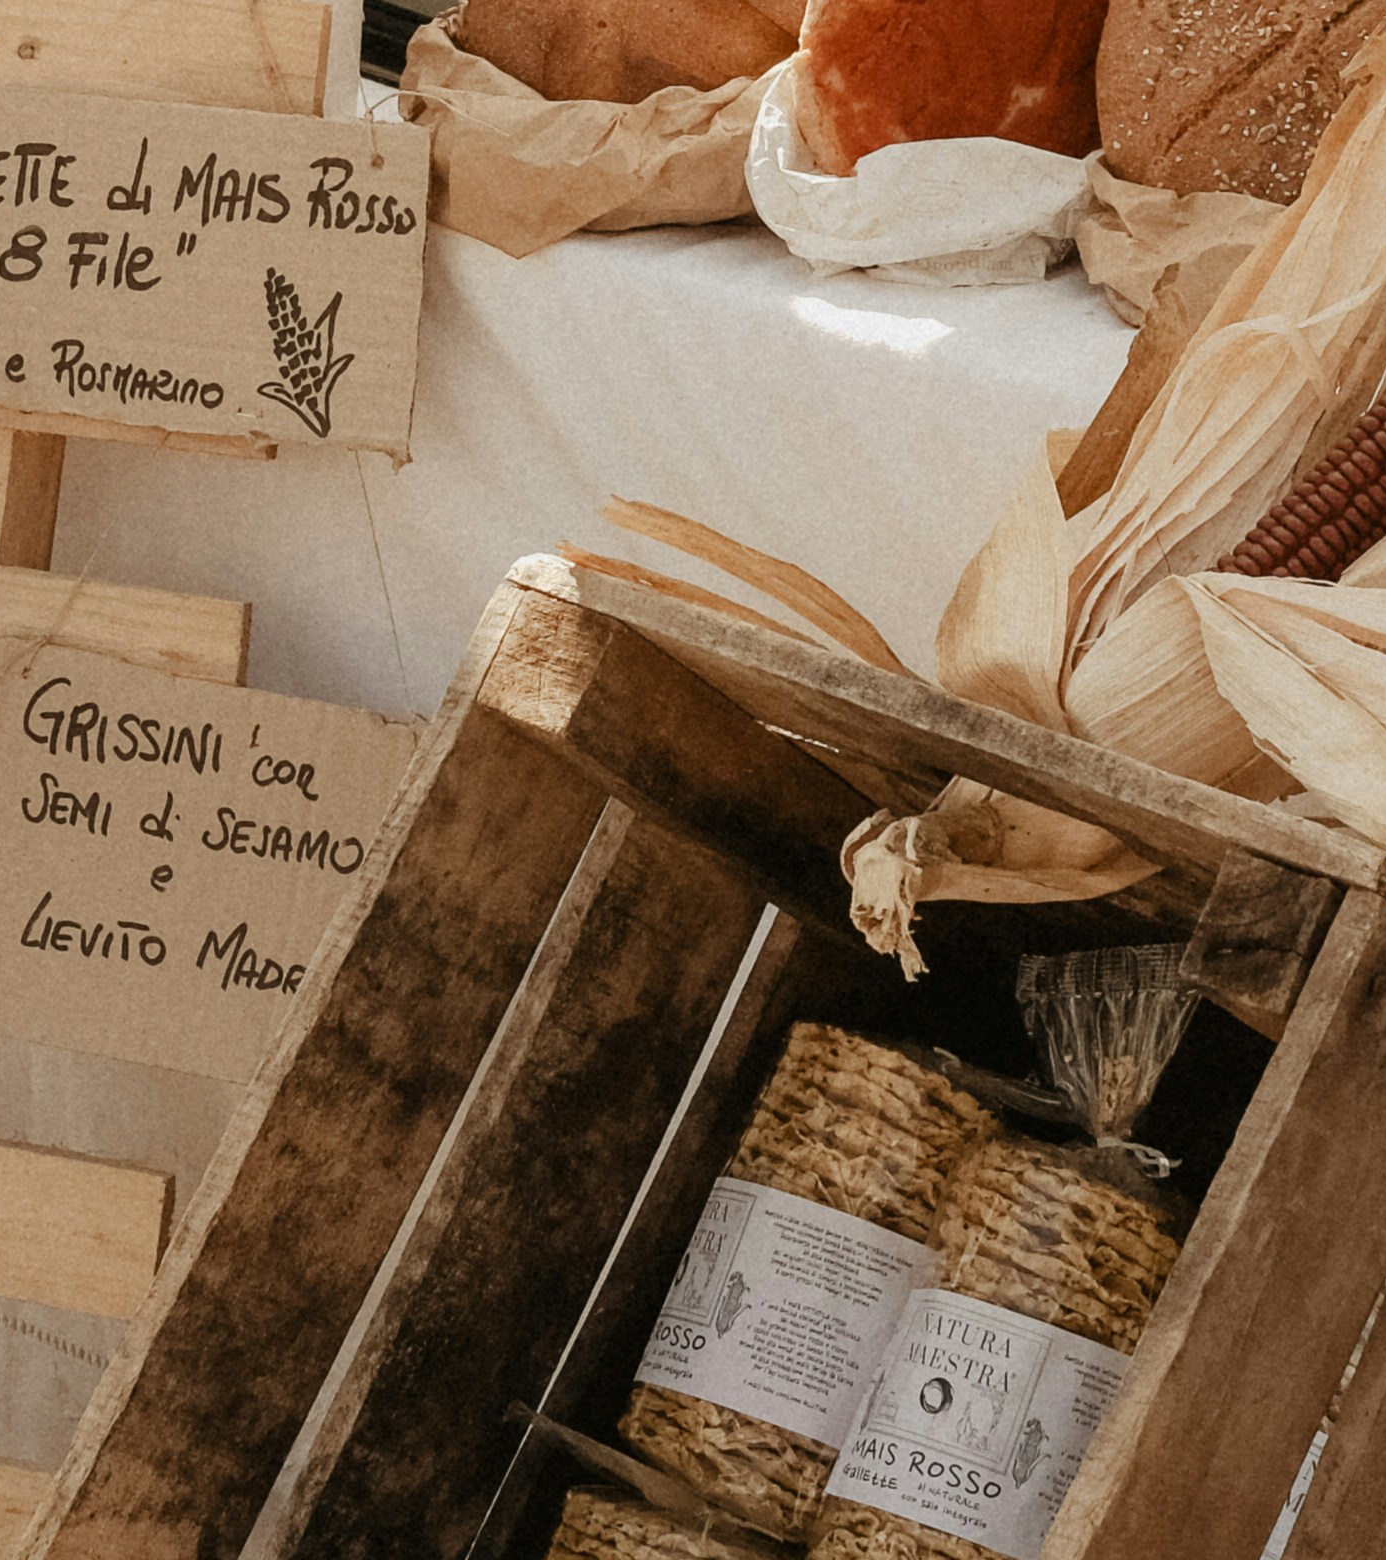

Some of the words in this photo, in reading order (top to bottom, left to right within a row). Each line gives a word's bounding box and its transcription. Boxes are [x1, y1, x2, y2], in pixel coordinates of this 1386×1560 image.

[106, 136, 152, 215] di
[173, 152, 290, 227] MAIS
[5, 351, 26, 382] e
[23, 678, 223, 774] GRISSINI
[21, 773, 112, 837] SEMI
[140, 791, 181, 841] di
[202, 806, 365, 875] SESAMO
[151, 864, 173, 892] e
[21, 891, 167, 967] LIEVITO
[197, 923, 307, 995] MADR
[923, 1312, 1012, 1359] NATURA
[905, 1342, 1011, 1394] MAESTRA
[852, 1437, 898, 1466] MAIS
[909, 1451, 1002, 1498] ROSSO
